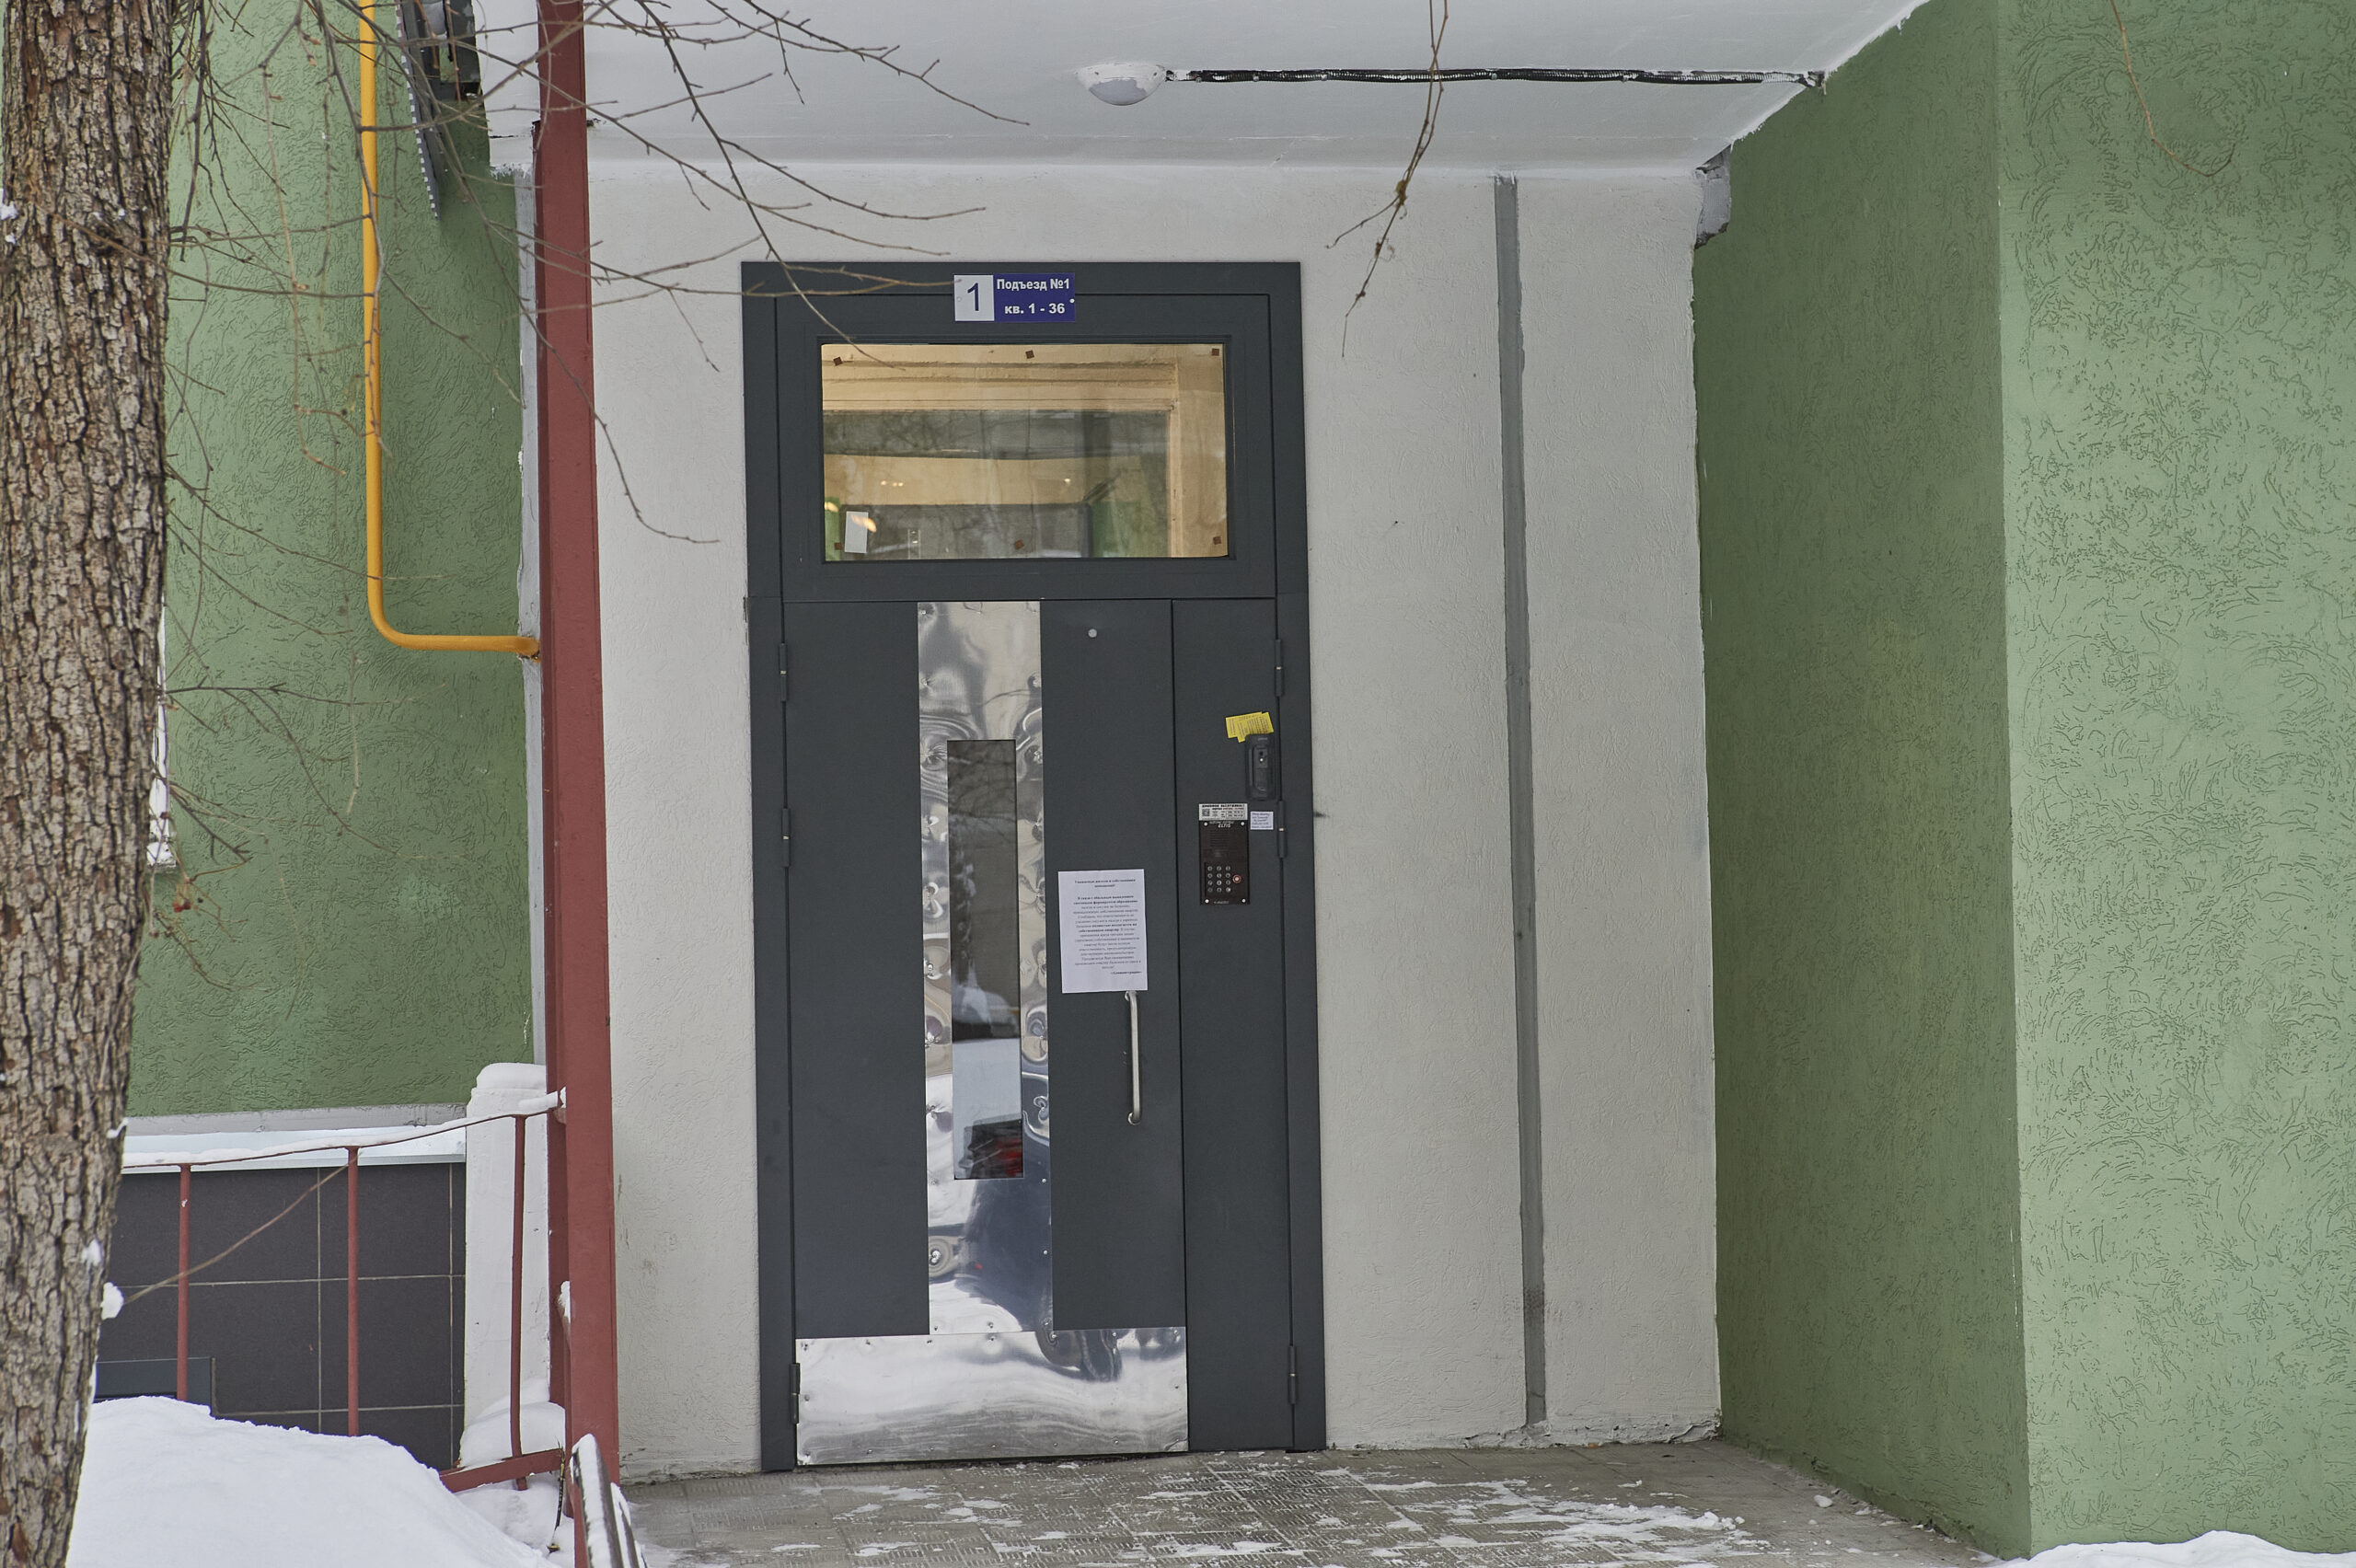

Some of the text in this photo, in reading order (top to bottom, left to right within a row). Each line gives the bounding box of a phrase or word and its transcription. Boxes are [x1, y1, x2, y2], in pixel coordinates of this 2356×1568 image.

[997, 278, 1069, 292] Подъезд №1
[967, 282, 979, 312] 1
[1004, 305, 1024, 314] кв.
[1028, 303, 1035, 314] 1
[1048, 303, 1066, 314] 36
